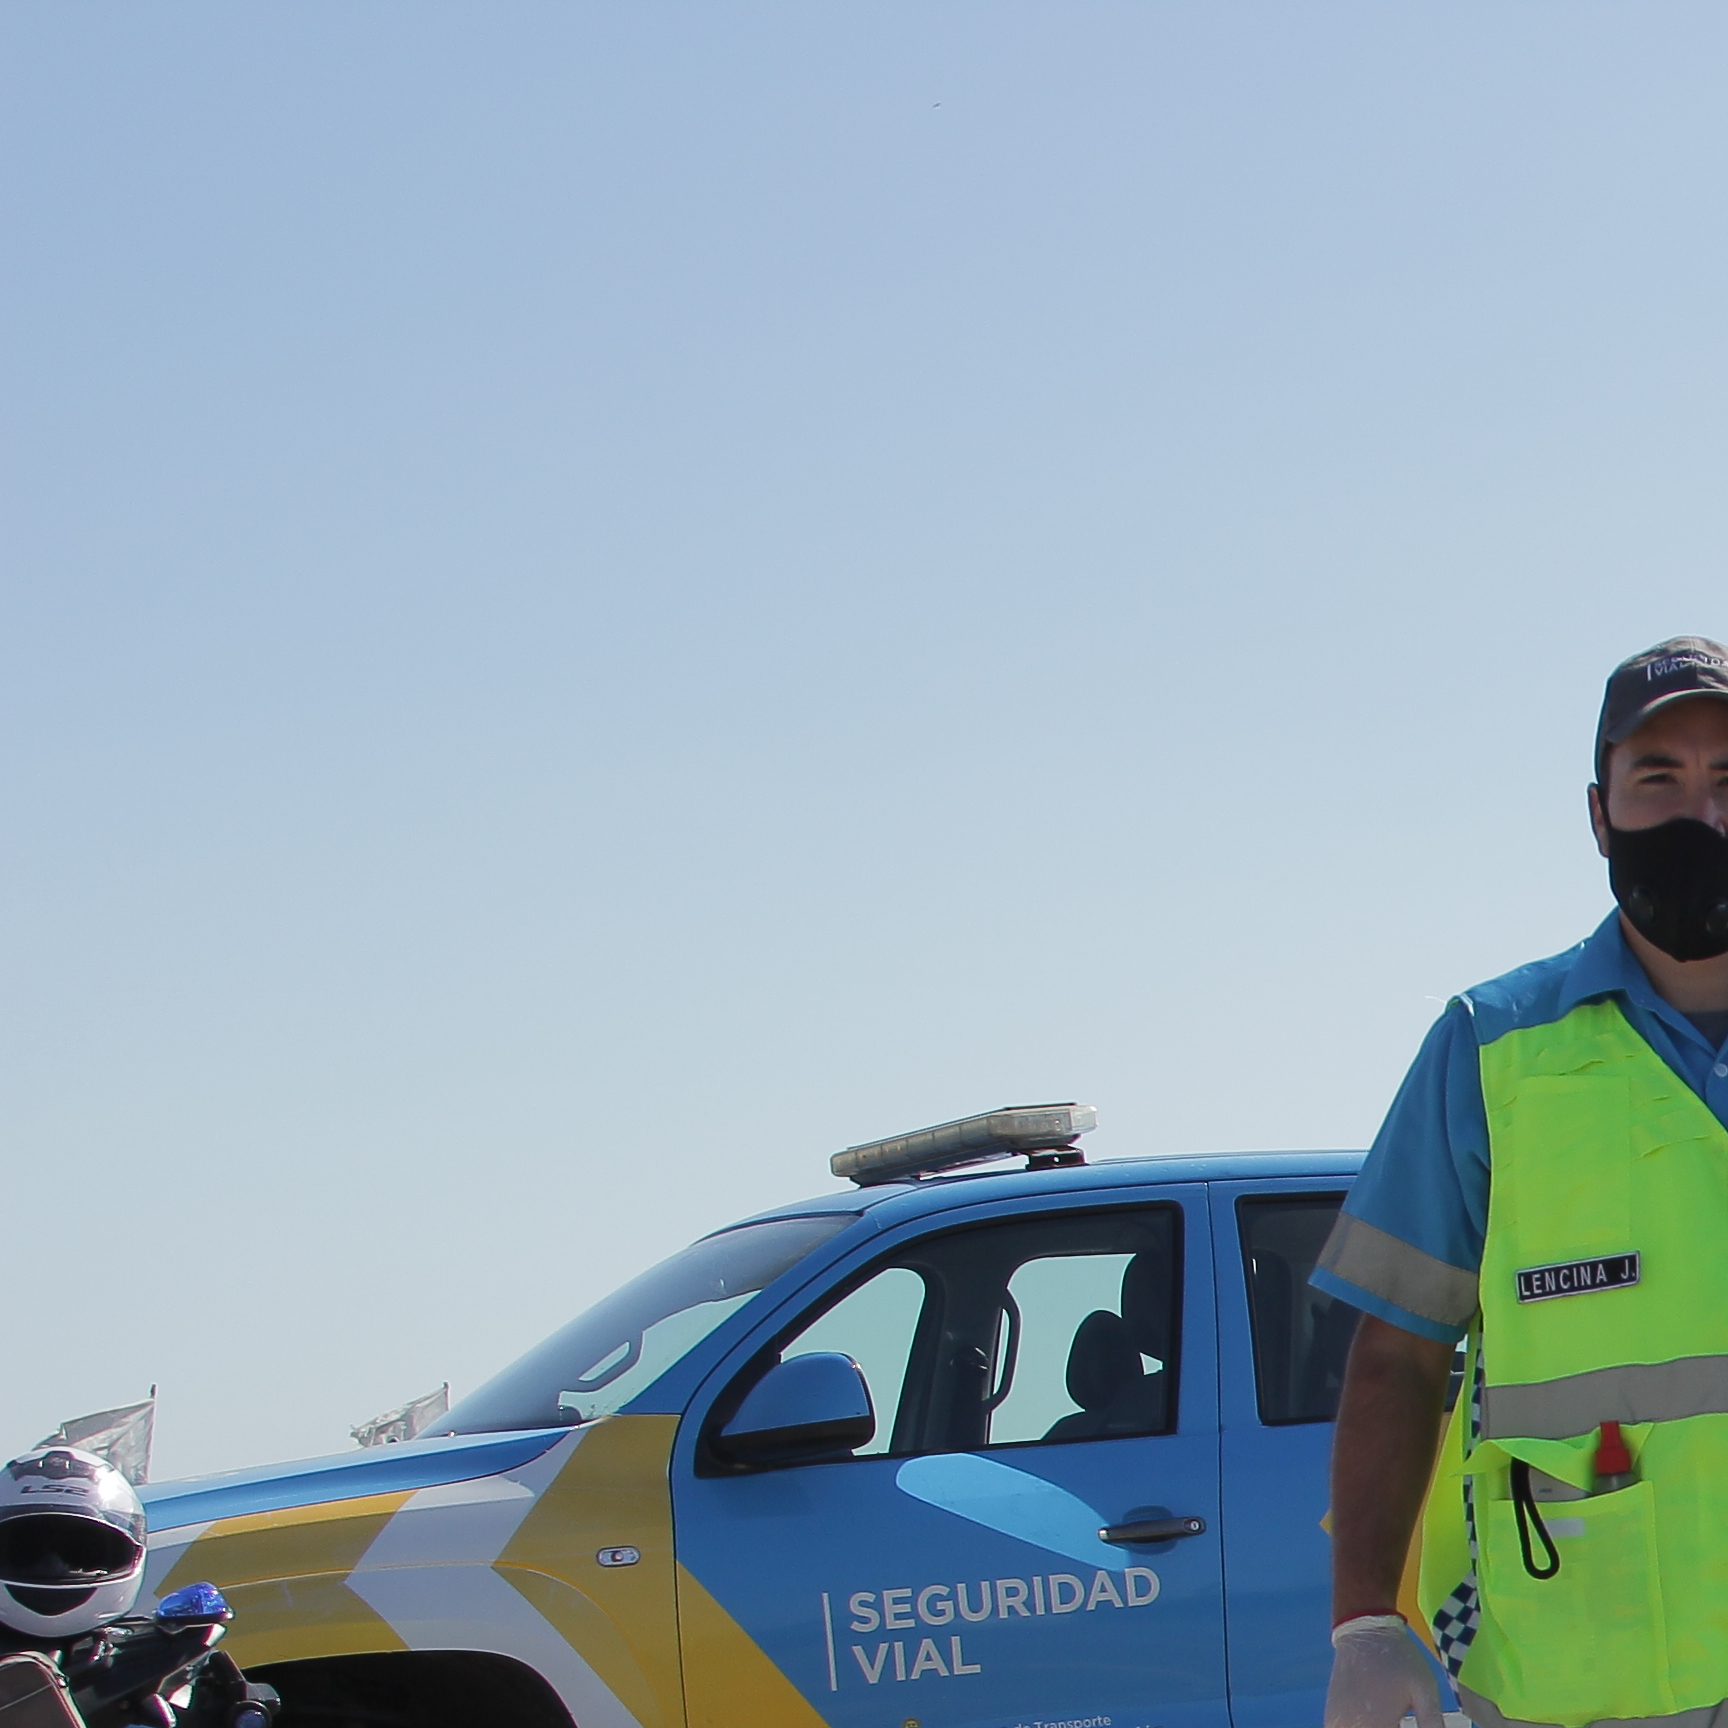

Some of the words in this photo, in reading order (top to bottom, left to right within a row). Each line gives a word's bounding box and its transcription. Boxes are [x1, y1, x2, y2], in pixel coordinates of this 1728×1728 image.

[1520, 1263, 1608, 1296] LENCINA
[1620, 1259, 1636, 1279] J.
[20, 1484, 90, 1497] LS2
[849, 1566, 1160, 1633] SEGURIDAD
[851, 1635, 982, 1685] VIAL
